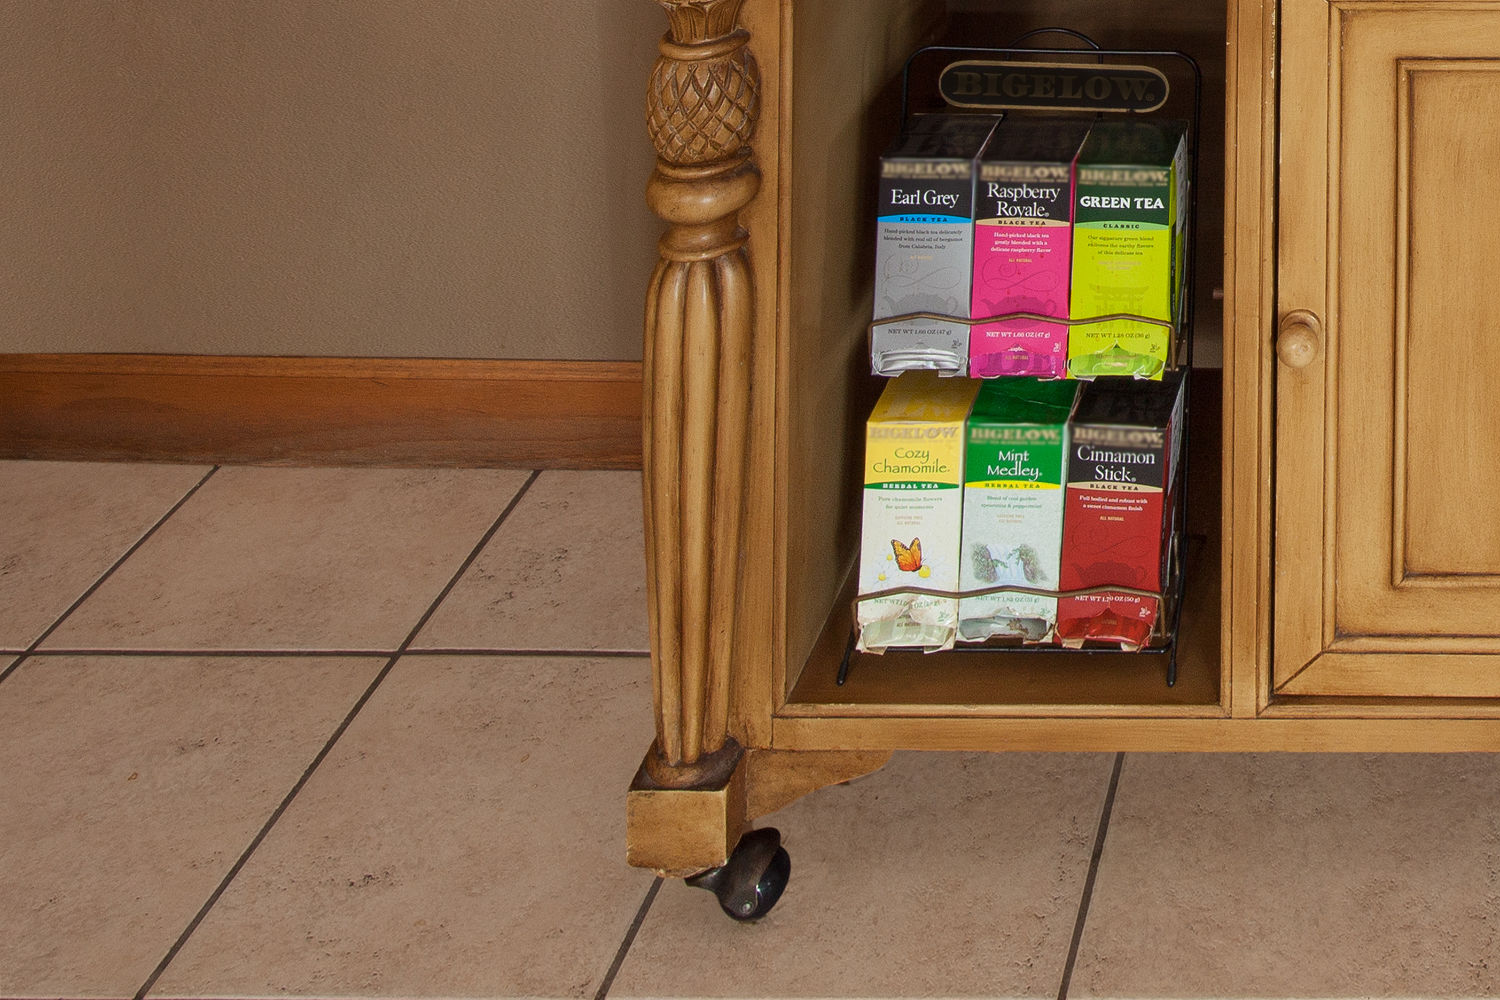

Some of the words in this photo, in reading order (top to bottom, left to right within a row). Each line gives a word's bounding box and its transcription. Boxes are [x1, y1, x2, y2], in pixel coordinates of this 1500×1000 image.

[953, 71, 1156, 101] BIGELOW
[891, 189, 920, 205] Earl
[924, 189, 960, 209] Grey
[987, 182, 1061, 202] Raspberry
[1080, 196, 1131, 209] GREEN
[1134, 198, 1165, 209] TEA
[895, 448, 930, 464] Cozy
[998, 449, 1030, 462] Mint
[1077, 445, 1155, 465] Cinnamon
